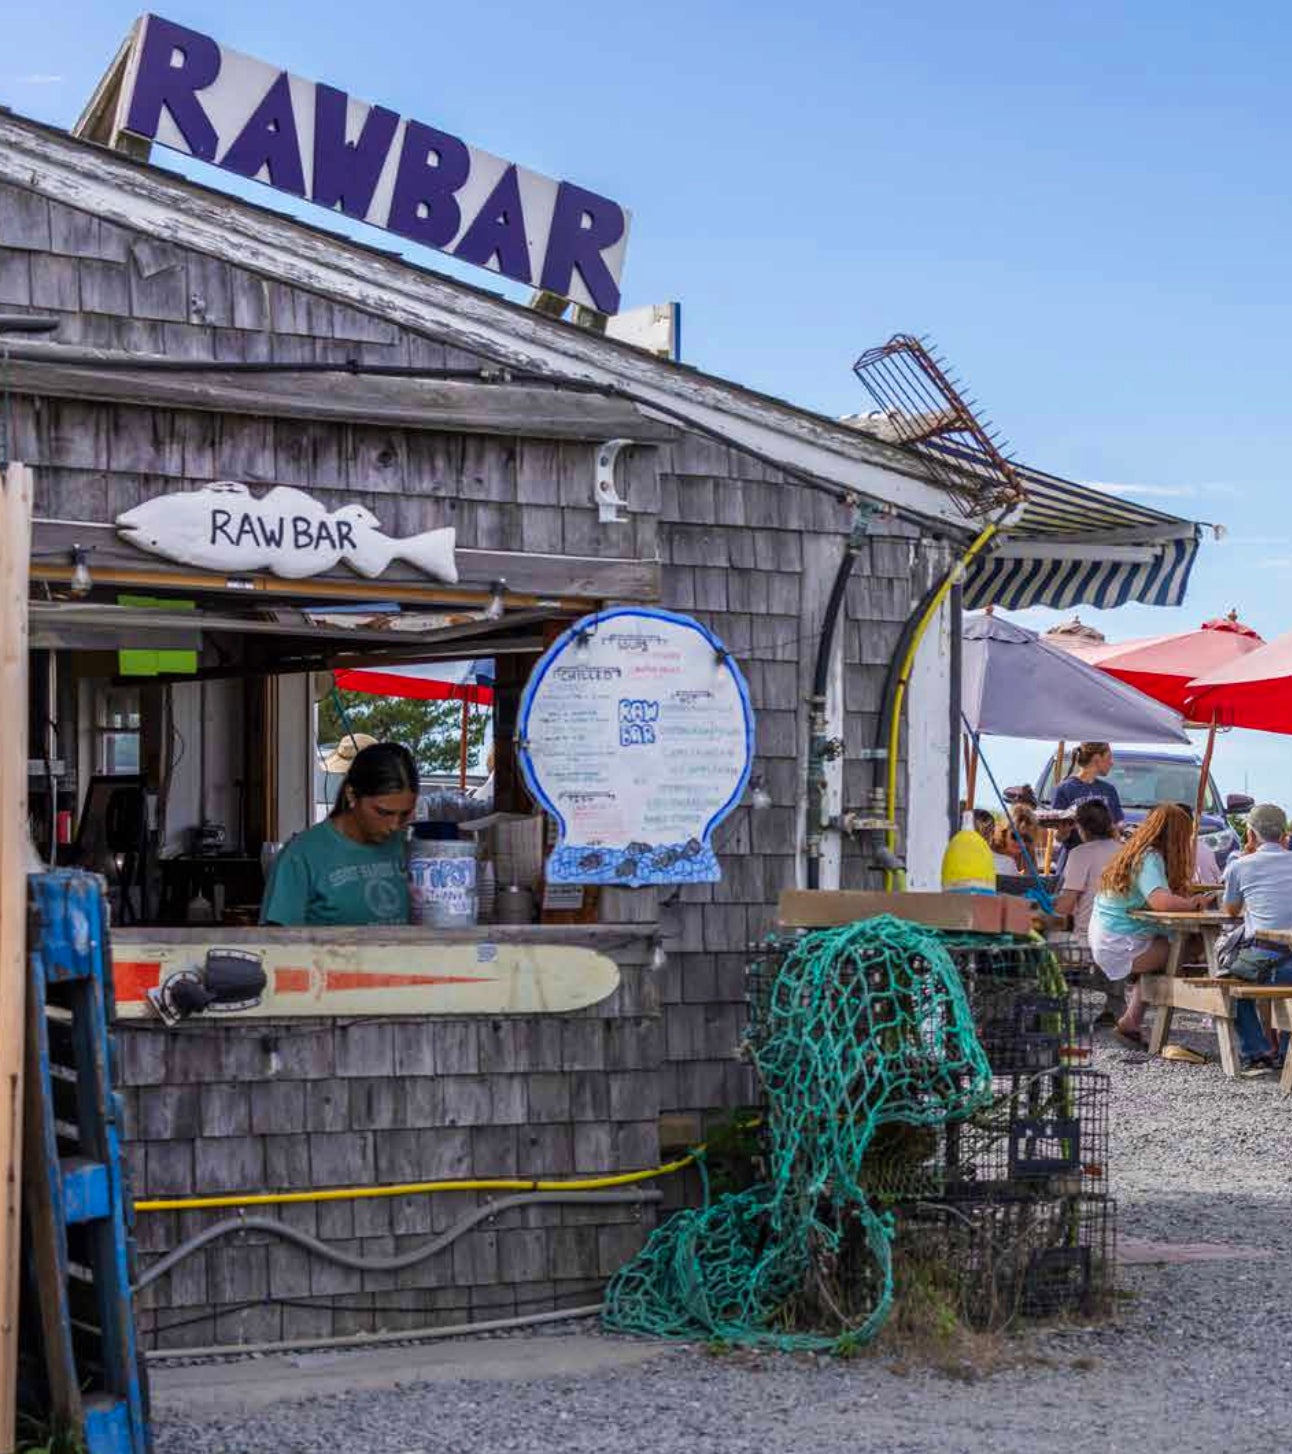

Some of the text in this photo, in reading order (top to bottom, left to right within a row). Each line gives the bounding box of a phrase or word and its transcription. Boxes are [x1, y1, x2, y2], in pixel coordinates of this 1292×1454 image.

[125, 13, 625, 316] RAWBAR
[210, 509, 357, 550] RAW BAR
[618, 698, 659, 723] RAW
[619, 724, 656, 747] BAR
